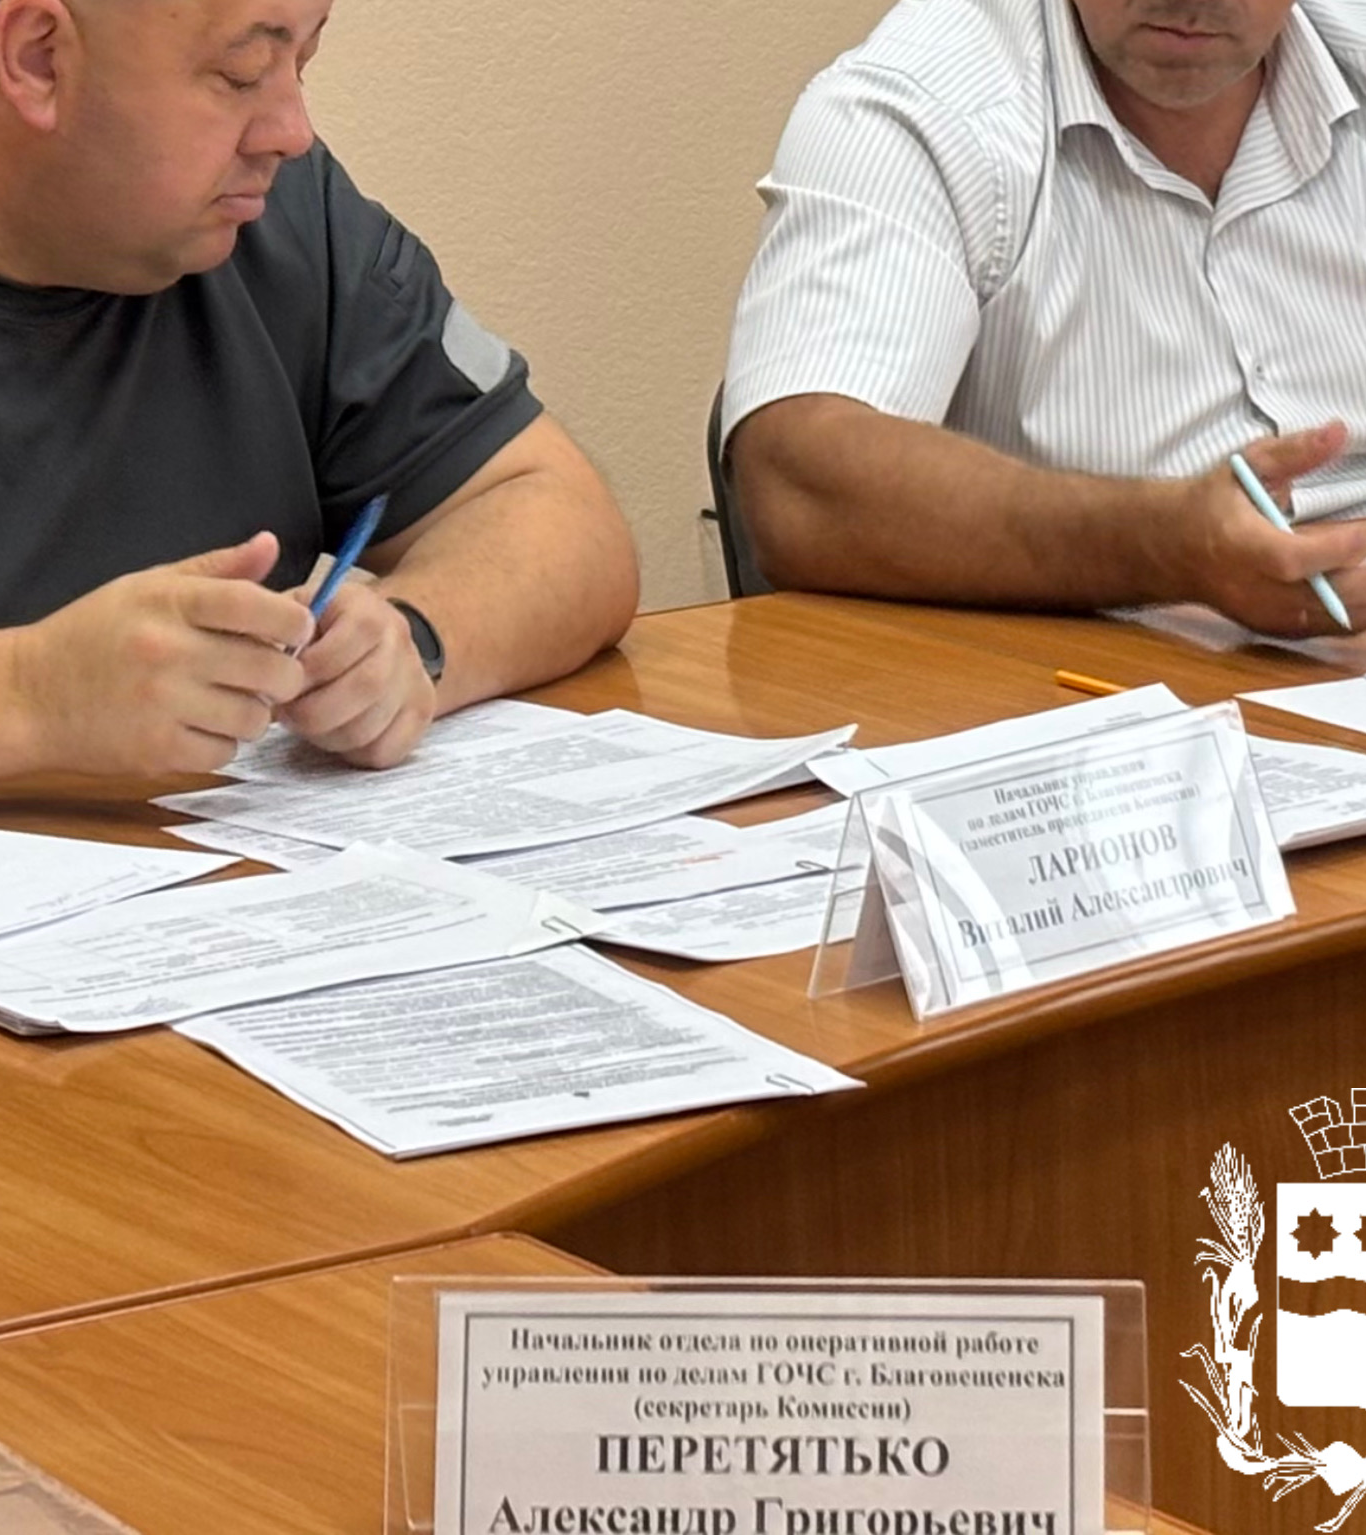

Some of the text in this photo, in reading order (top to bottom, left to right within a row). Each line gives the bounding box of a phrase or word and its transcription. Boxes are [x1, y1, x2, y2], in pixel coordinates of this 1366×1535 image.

[994, 777, 1069, 805] Начальник
[1026, 793, 1072, 817] ГОЧС
[958, 820, 1046, 854] (заместитель
[1028, 823, 1178, 885] ЛАРИОНОВ
[957, 857, 1250, 949] Виталий Александрович
[510, 1327, 1040, 1360] Начальник отдела по оперативной работе
[481, 1361, 1067, 1390] управления по делам ГОЧС г. Благовещенска
[633, 1395, 912, 1425] (секретарь Комиссии)
[595, 1434, 951, 1477] ПЕРЕТЯТЬКО
[487, 1495, 1058, 1535] Александр Григорьевич
